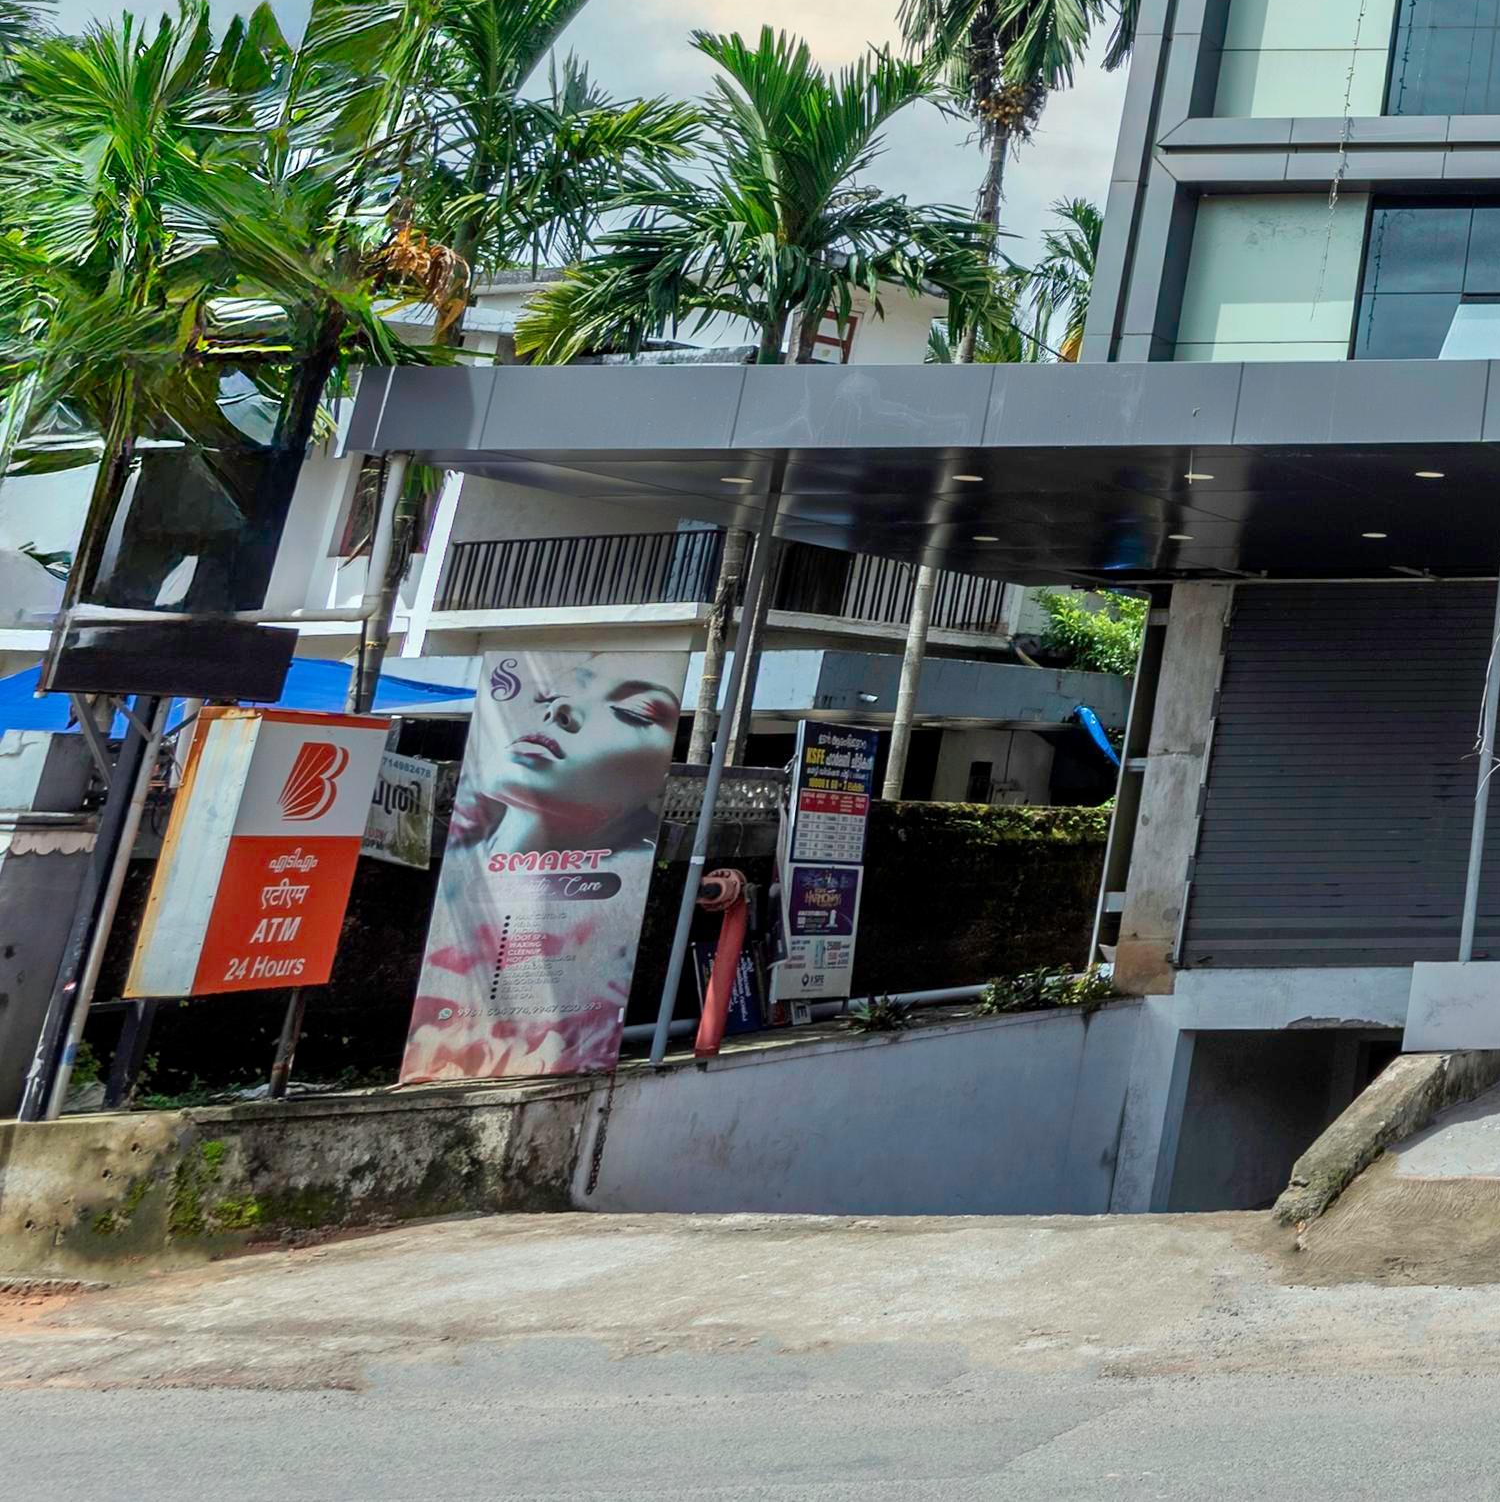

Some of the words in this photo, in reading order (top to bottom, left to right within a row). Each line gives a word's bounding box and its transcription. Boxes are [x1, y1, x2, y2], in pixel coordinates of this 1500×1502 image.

[487, 848, 613, 873] SMART
[261, 877, 310, 910] एटीएम
[558, 875, 603, 897] Care
[249, 916, 302, 944] ATM
[223, 957, 250, 981] 24
[250, 955, 306, 979] Hours
